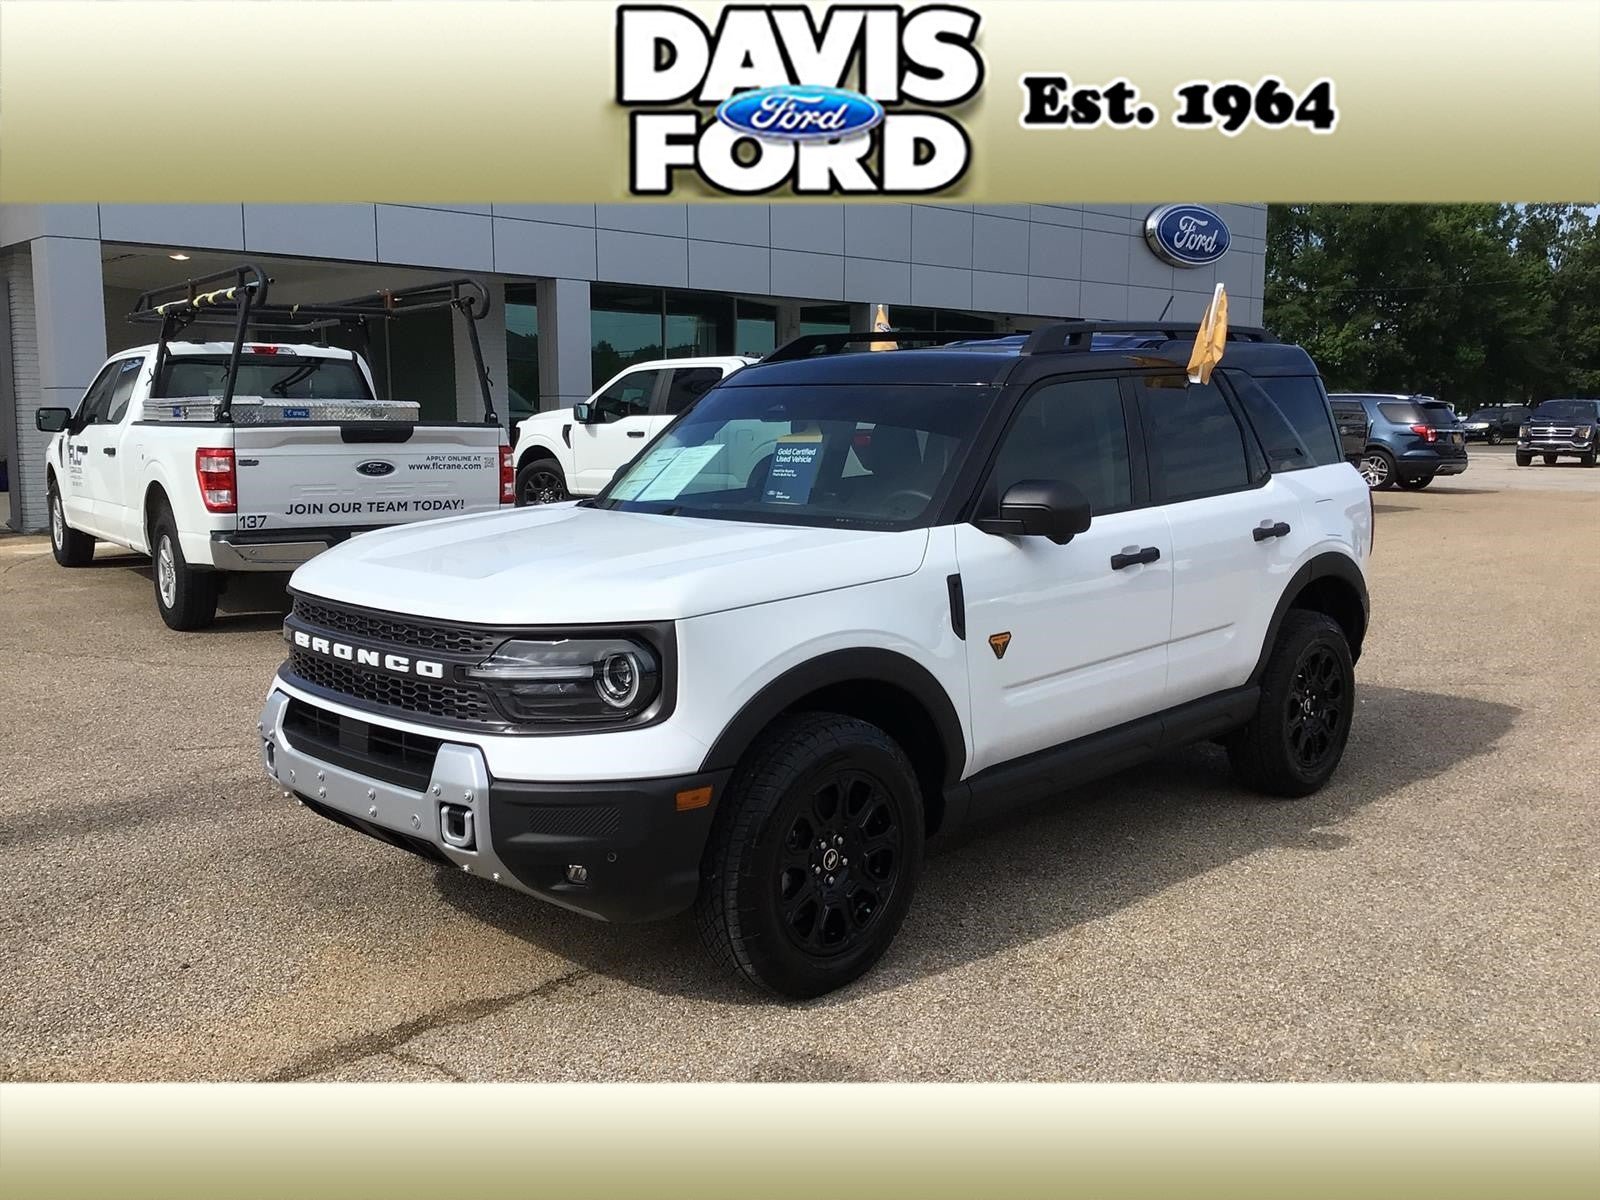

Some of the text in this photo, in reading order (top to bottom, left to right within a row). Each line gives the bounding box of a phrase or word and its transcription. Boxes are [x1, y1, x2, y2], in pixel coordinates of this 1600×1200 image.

[1173, 215, 1219, 254] Ford
[777, 448, 816, 456] Gold Certified
[408, 462, 482, 471] www.flcrane.com
[285, 499, 465, 515] JOIN OUR TEAM TODAY!
[239, 515, 267, 529] 137
[294, 630, 444, 679] BRONCO
